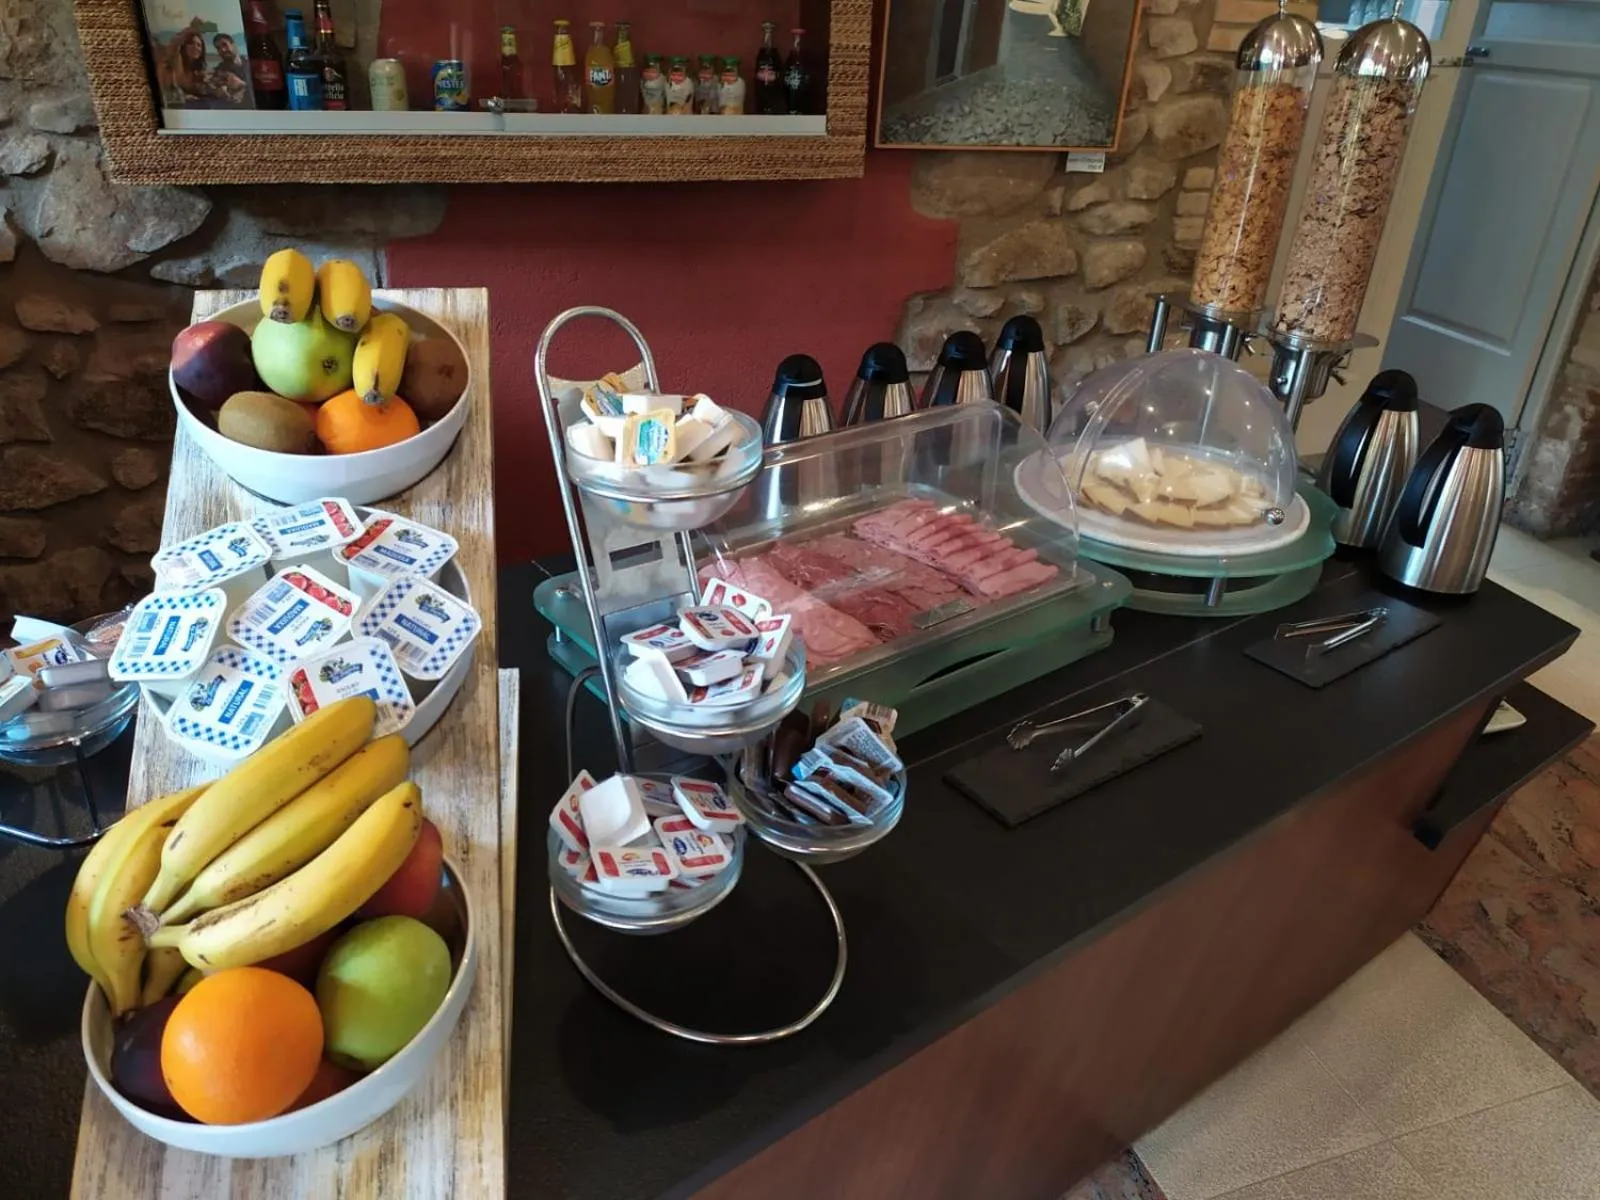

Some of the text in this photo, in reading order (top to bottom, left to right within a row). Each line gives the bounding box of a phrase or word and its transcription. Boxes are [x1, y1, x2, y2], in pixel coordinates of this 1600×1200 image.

[273, 604, 304, 630] MADUIXA
[400, 618, 431, 641] NATURAL
[222, 684, 250, 720] NATURAL
